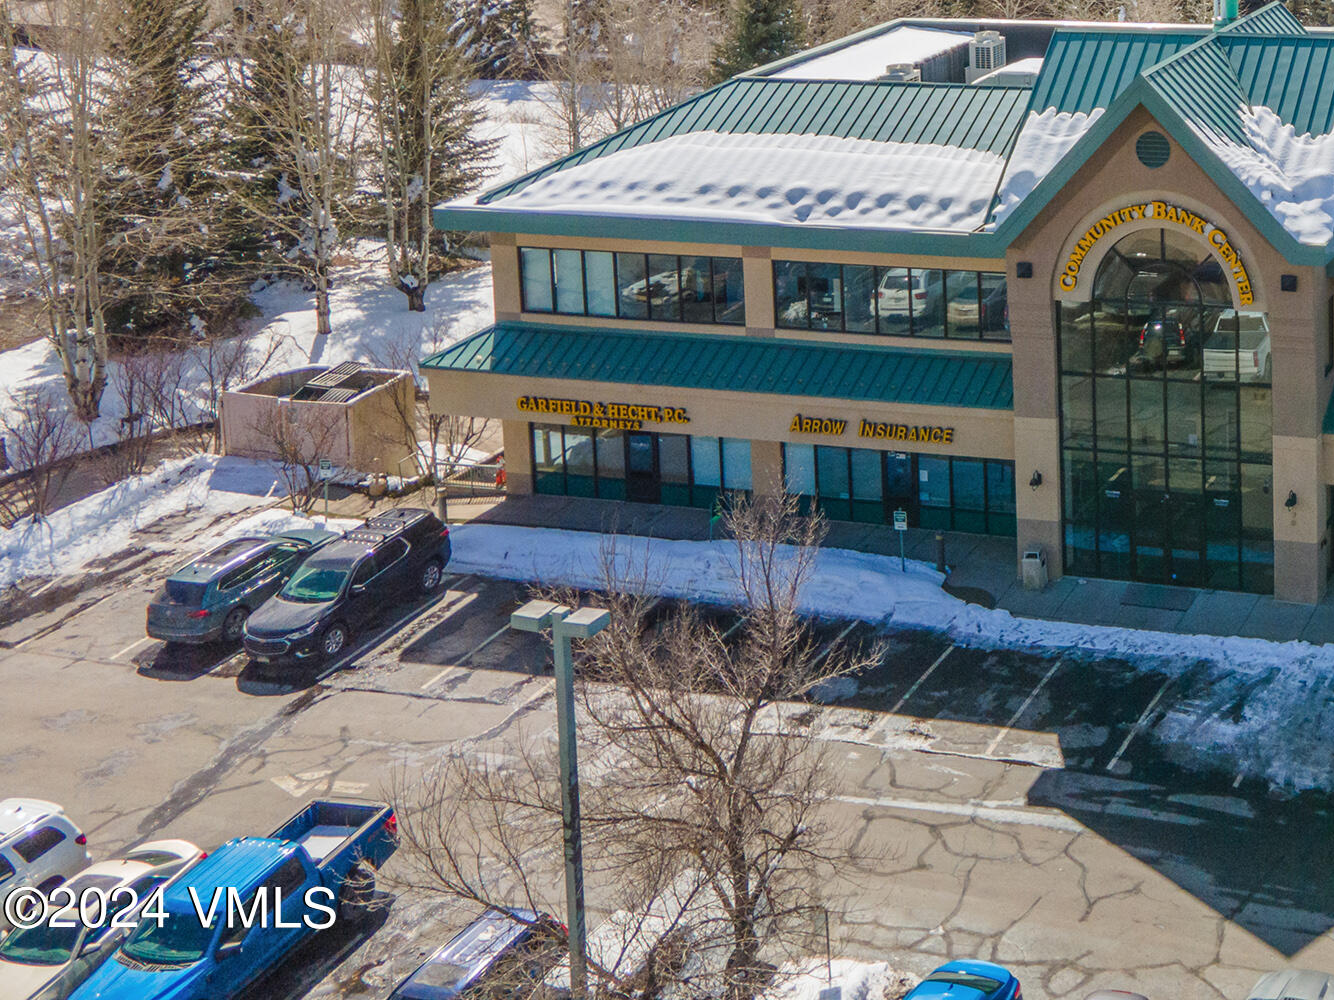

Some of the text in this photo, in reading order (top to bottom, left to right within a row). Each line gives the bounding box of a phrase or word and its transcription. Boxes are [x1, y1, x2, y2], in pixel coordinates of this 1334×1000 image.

[1060, 201, 1254, 306] COMMUNITY BANK CENTER
[516, 396, 591, 416] GARFIELD
[593, 402, 604, 417] &
[664, 408, 690, 424] P.C.
[570, 416, 641, 430] ATTORNEYS
[790, 414, 954, 445] ARROW INSURANCE
